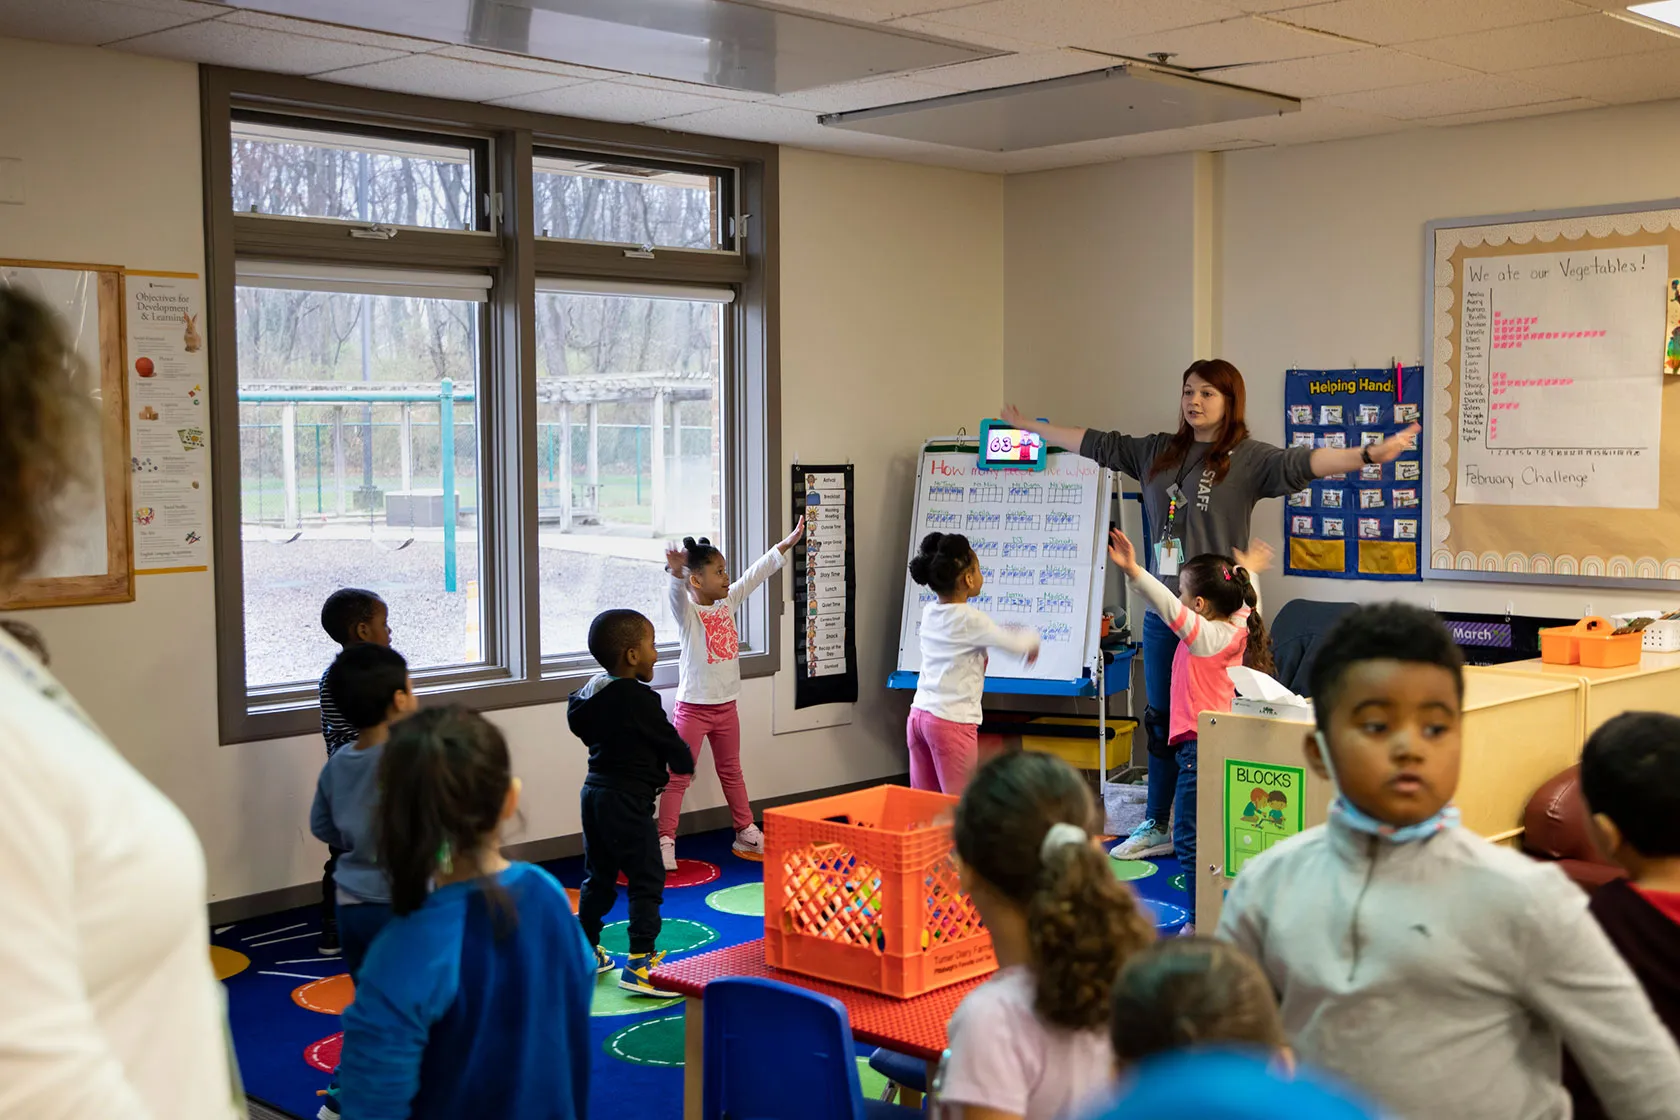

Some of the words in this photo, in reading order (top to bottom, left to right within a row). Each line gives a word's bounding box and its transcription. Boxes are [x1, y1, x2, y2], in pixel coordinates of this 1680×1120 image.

[1469, 264, 1490, 283] We
[1497, 263, 1521, 281] ate
[1530, 268, 1549, 280] our
[135, 291, 177, 303] Objectives
[178, 294, 190, 303] for
[137, 301, 189, 314] Development
[141, 312, 149, 321] &
[152, 312, 187, 324] Learning
[1309, 378, 1356, 395] Helping
[990, 436, 1012, 453] 63
[931, 459, 965, 476] How
[971, 466, 999, 481] many
[1465, 464, 1514, 489] February
[1196, 469, 1216, 512] STAFF
[1452, 627, 1492, 641] March
[1236, 767, 1291, 788] BLOCKS
